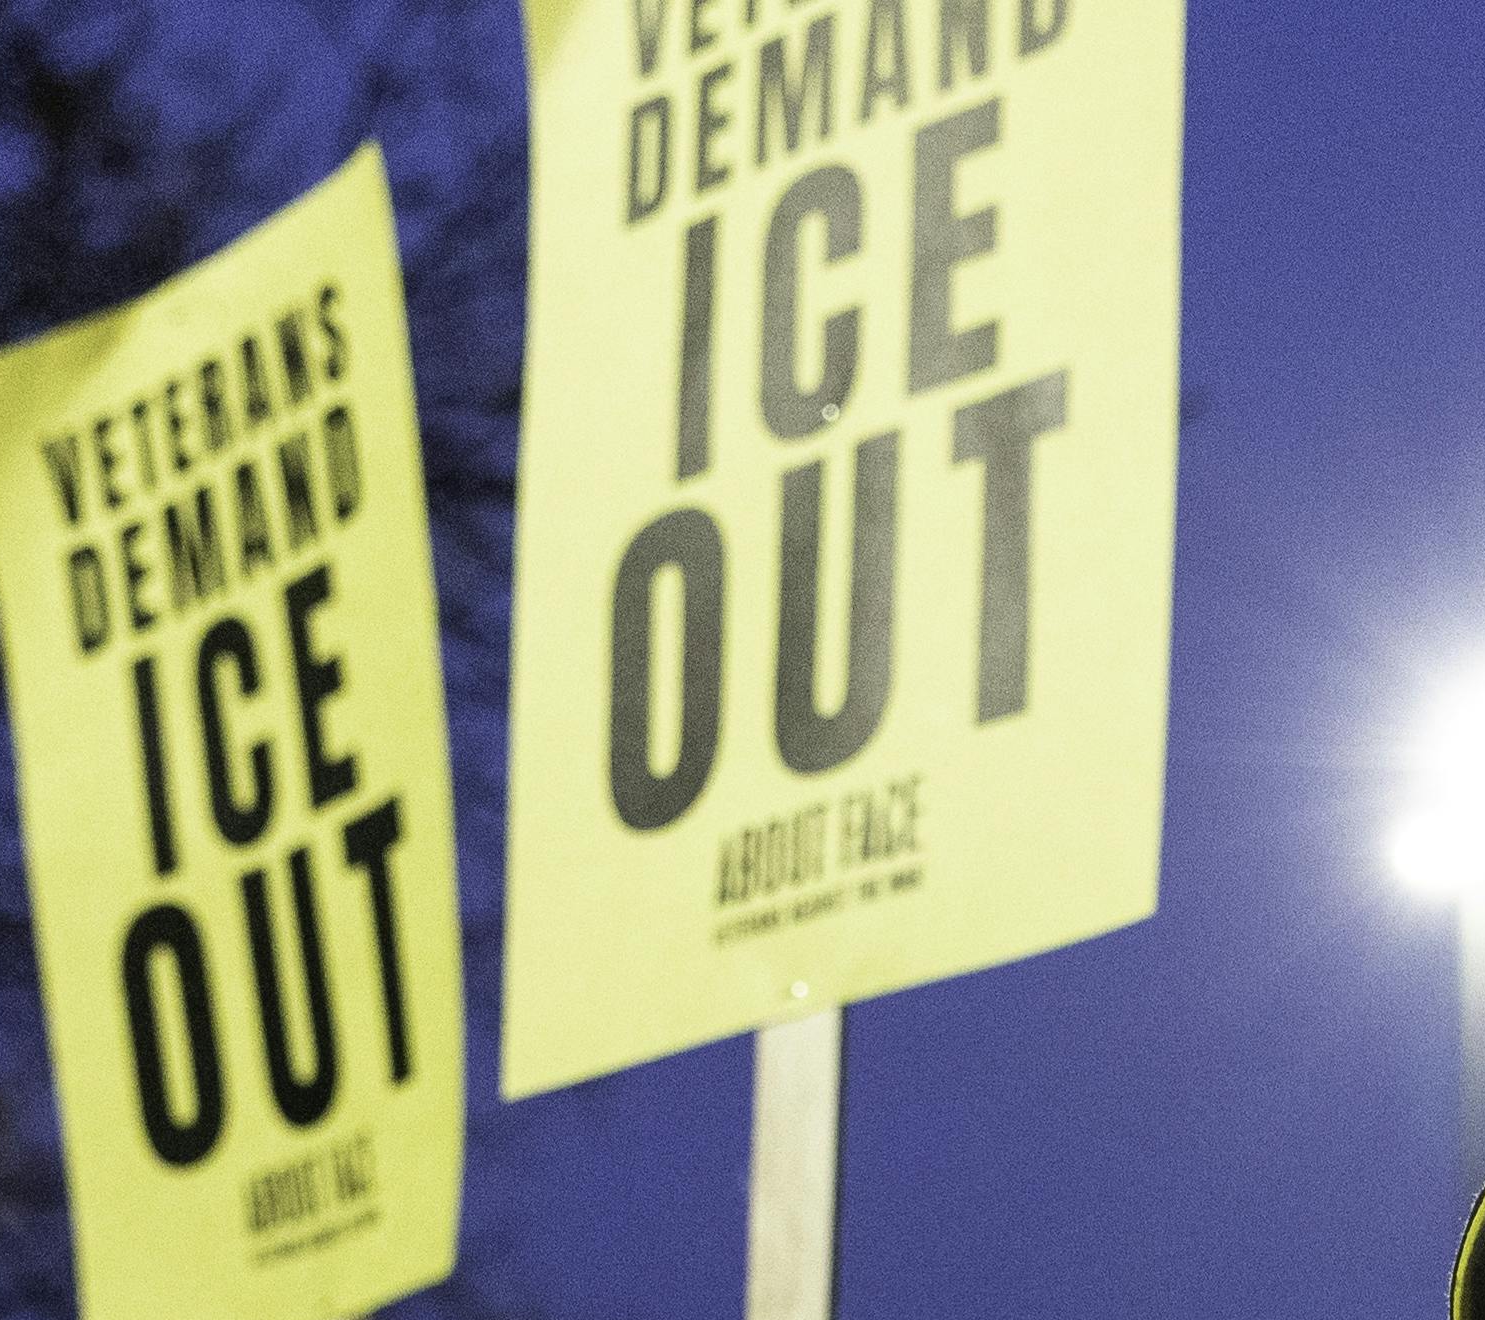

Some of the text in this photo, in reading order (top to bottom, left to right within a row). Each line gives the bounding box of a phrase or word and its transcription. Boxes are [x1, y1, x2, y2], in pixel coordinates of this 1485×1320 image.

[42, 284, 347, 525] VETERANS
[675, 94, 1004, 484] ICE
[65, 405, 364, 660] DEMAND
[607, 367, 1072, 835] OUT
[131, 560, 361, 877] ICE
[119, 794, 414, 1172] OUT
